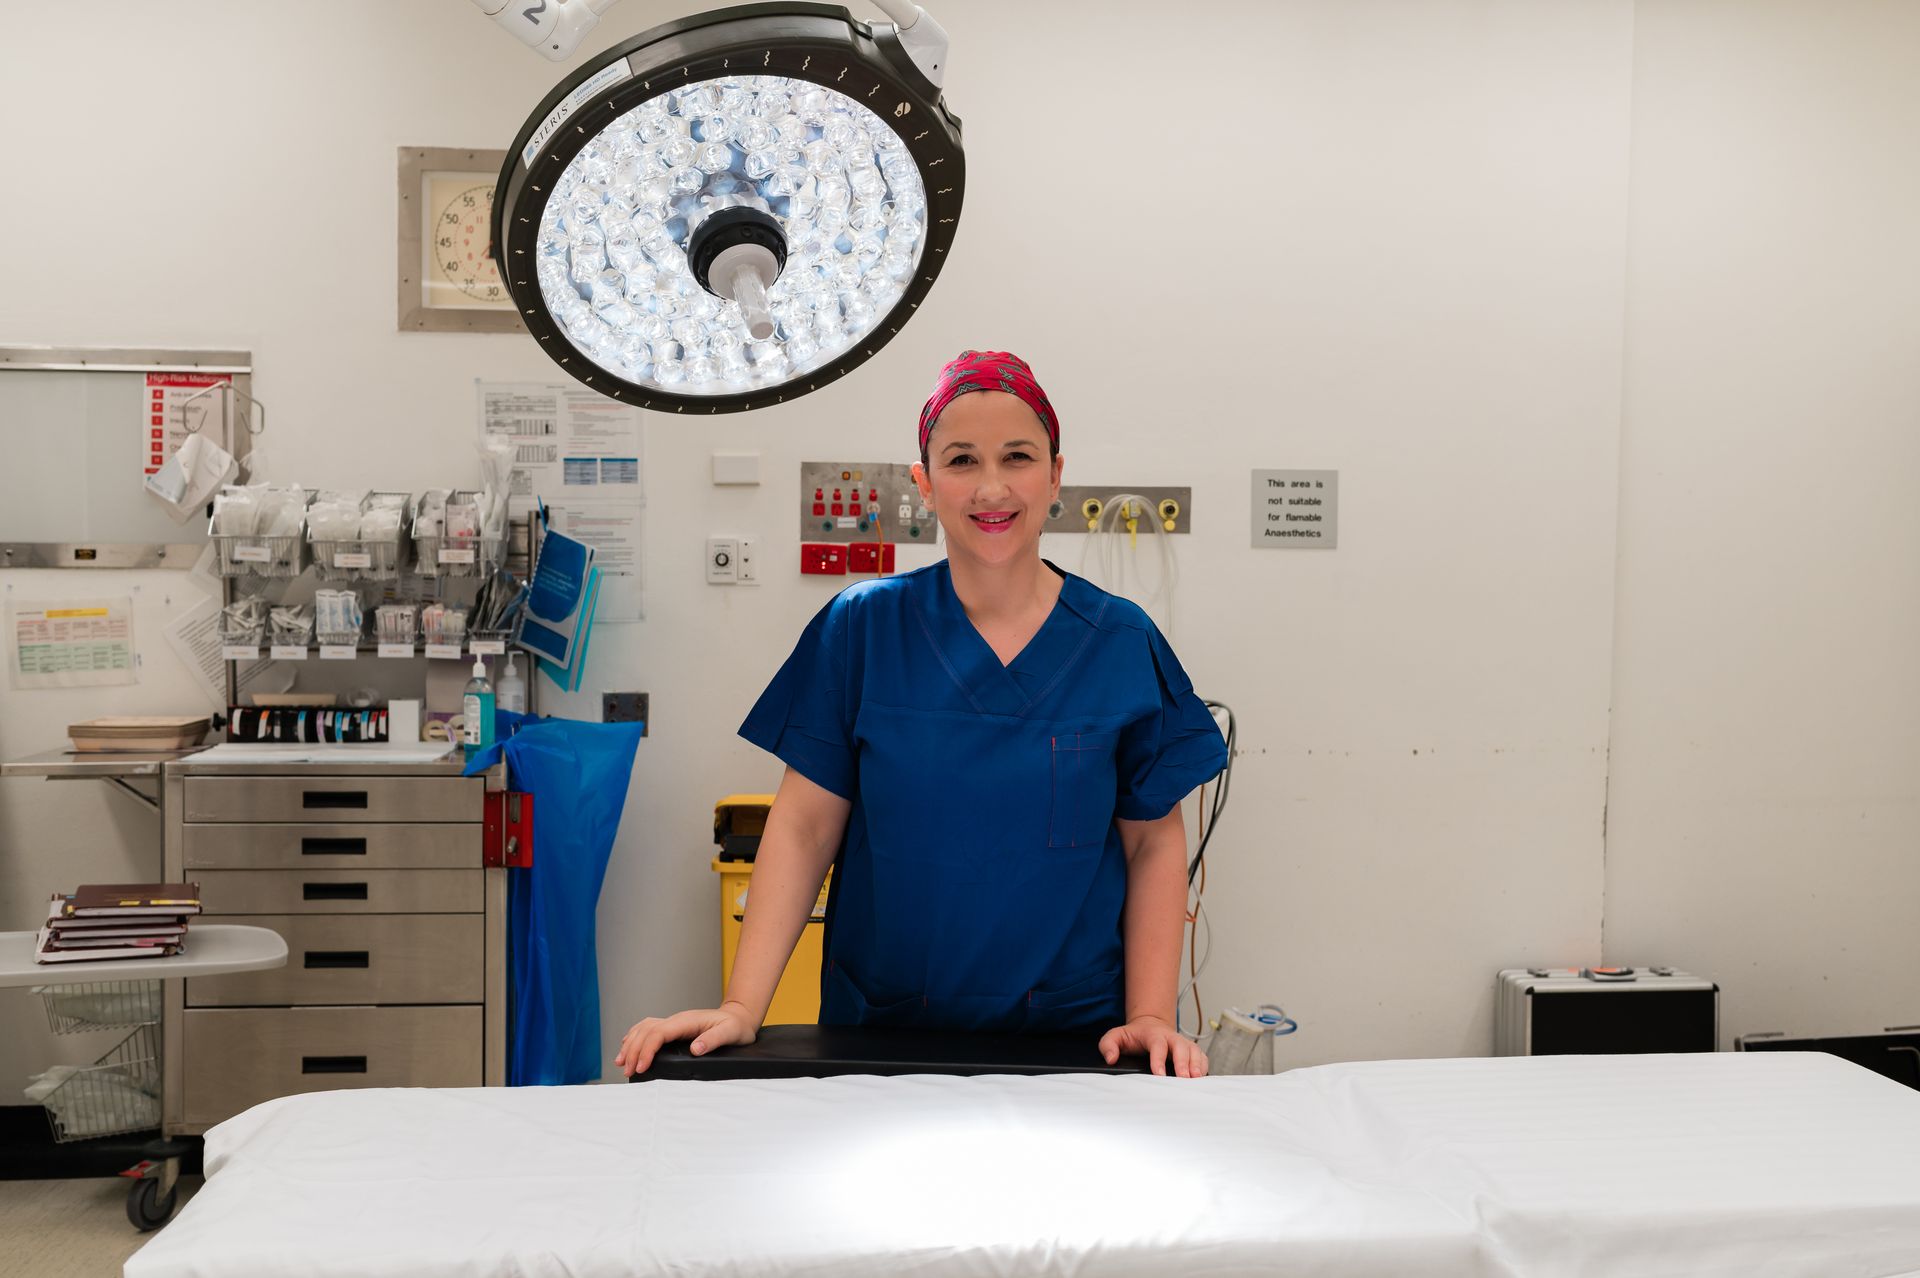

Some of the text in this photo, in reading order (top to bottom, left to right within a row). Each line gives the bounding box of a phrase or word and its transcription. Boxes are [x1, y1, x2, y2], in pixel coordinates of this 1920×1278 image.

[522, 0, 546, 26] 2
[534, 105, 568, 148] STERIS
[463, 196, 475, 207] 55
[446, 213, 459, 224] 50
[440, 238, 452, 248] 45
[446, 262, 458, 272] 40
[487, 286, 499, 297] 30
[1267, 479, 1323, 488] This area is
[1268, 497, 1322, 506] not suitable
[1268, 513, 1322, 522] for flamable
[1264, 528, 1321, 538] Anaesthetics
